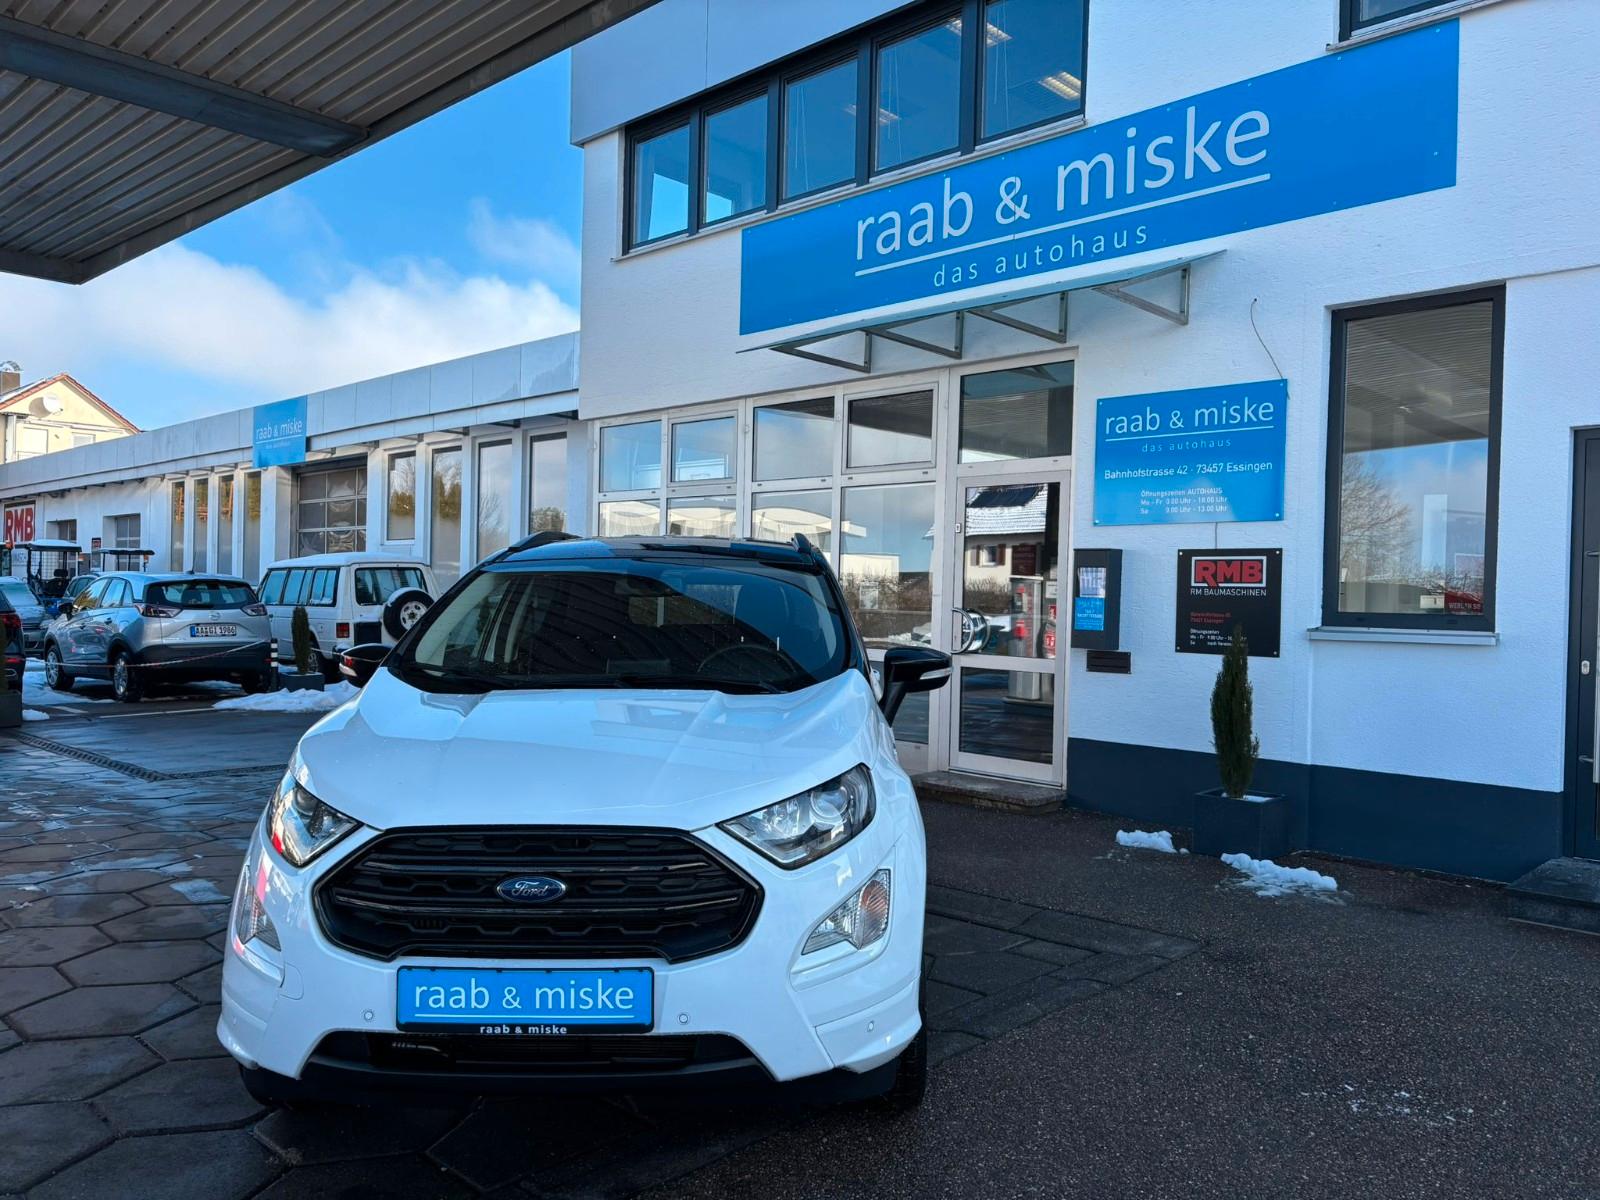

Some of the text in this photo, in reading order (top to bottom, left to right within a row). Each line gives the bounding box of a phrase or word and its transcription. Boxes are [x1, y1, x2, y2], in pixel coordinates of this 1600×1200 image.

[855, 105, 1270, 260] raab & miske
[933, 224, 1148, 287] das autohaus
[256, 423, 272, 440] raab
[280, 416, 303, 436] miske
[1105, 397, 1274, 435] raab & miske
[1142, 438, 1231, 453] das autohaus
[1104, 467, 1175, 479] Bahnhofstrasse
[1176, 465, 1188, 475] 42
[1196, 463, 1223, 474] 73457
[1226, 461, 1273, 474] Essingen
[5, 507, 34, 545] RMB
[1195, 560, 1262, 588] RMB
[1190, 588, 1267, 596] RM BAUMASCHINEN
[511, 880, 549, 898] Ford
[414, 977, 635, 1010] raab & miske
[480, 1024, 568, 1035] raab & miske
